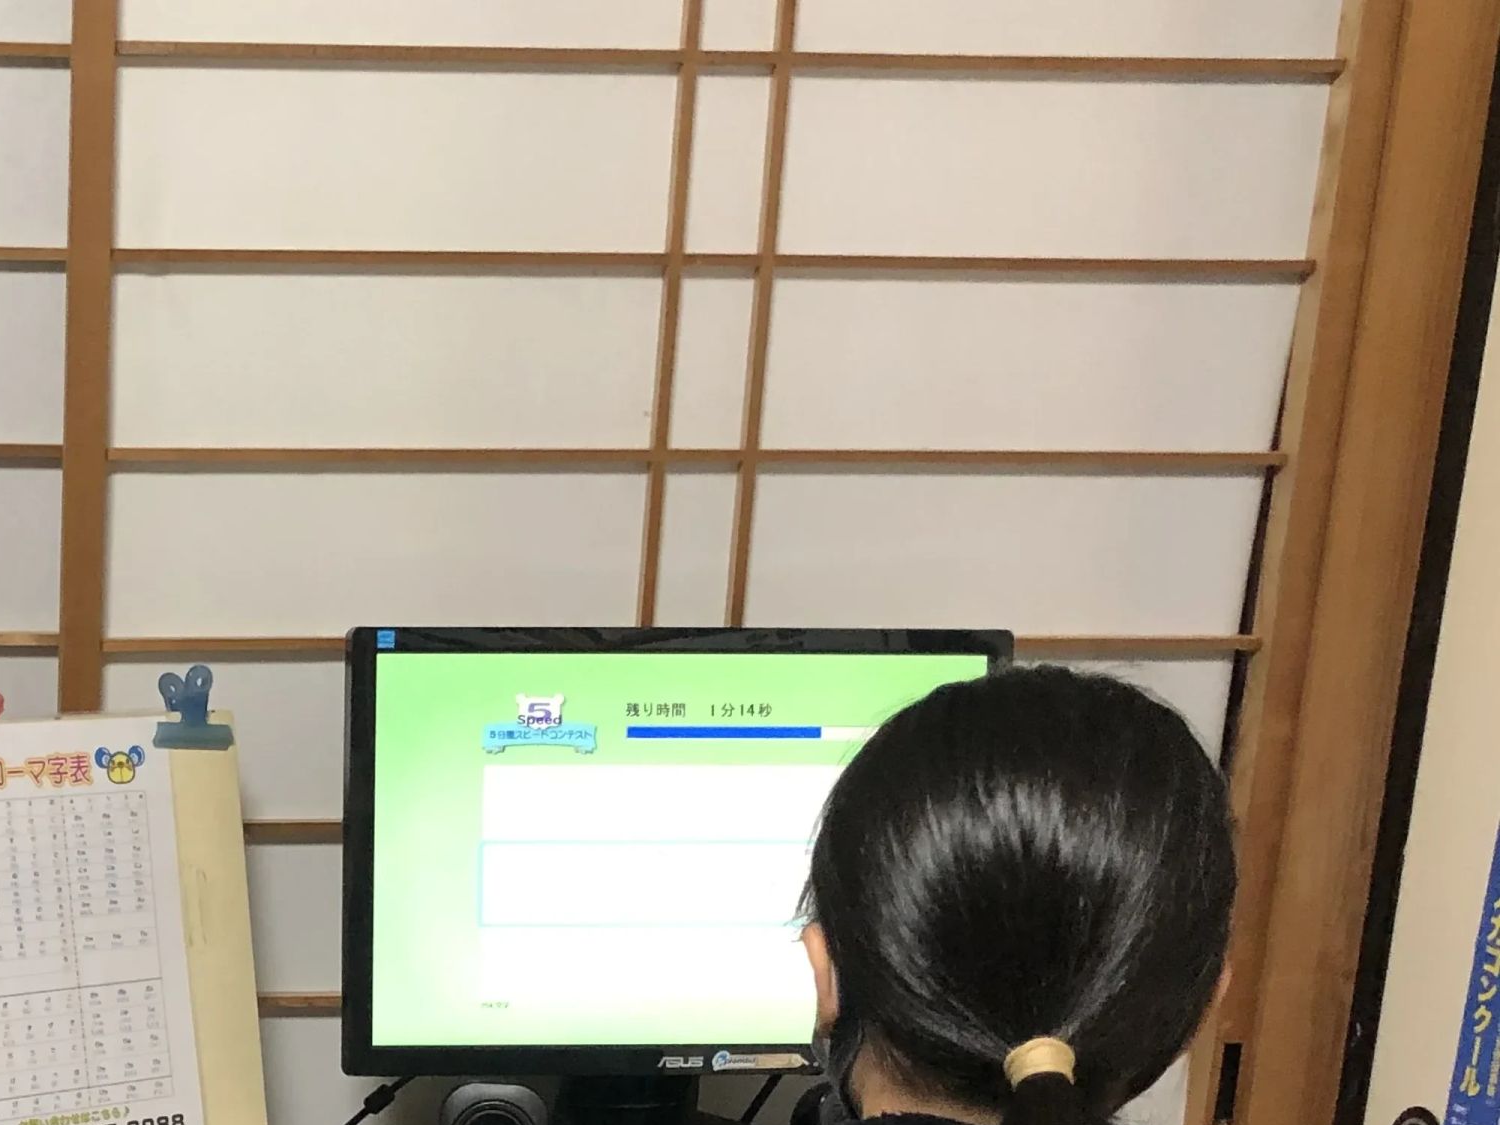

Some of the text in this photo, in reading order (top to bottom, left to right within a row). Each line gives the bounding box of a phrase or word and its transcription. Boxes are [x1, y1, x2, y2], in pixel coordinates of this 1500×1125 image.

[626, 703, 773, 718] 残り時間 1分14秒
[517, 714, 563, 727] Speed
[657, 1056, 704, 1068] ASUS
